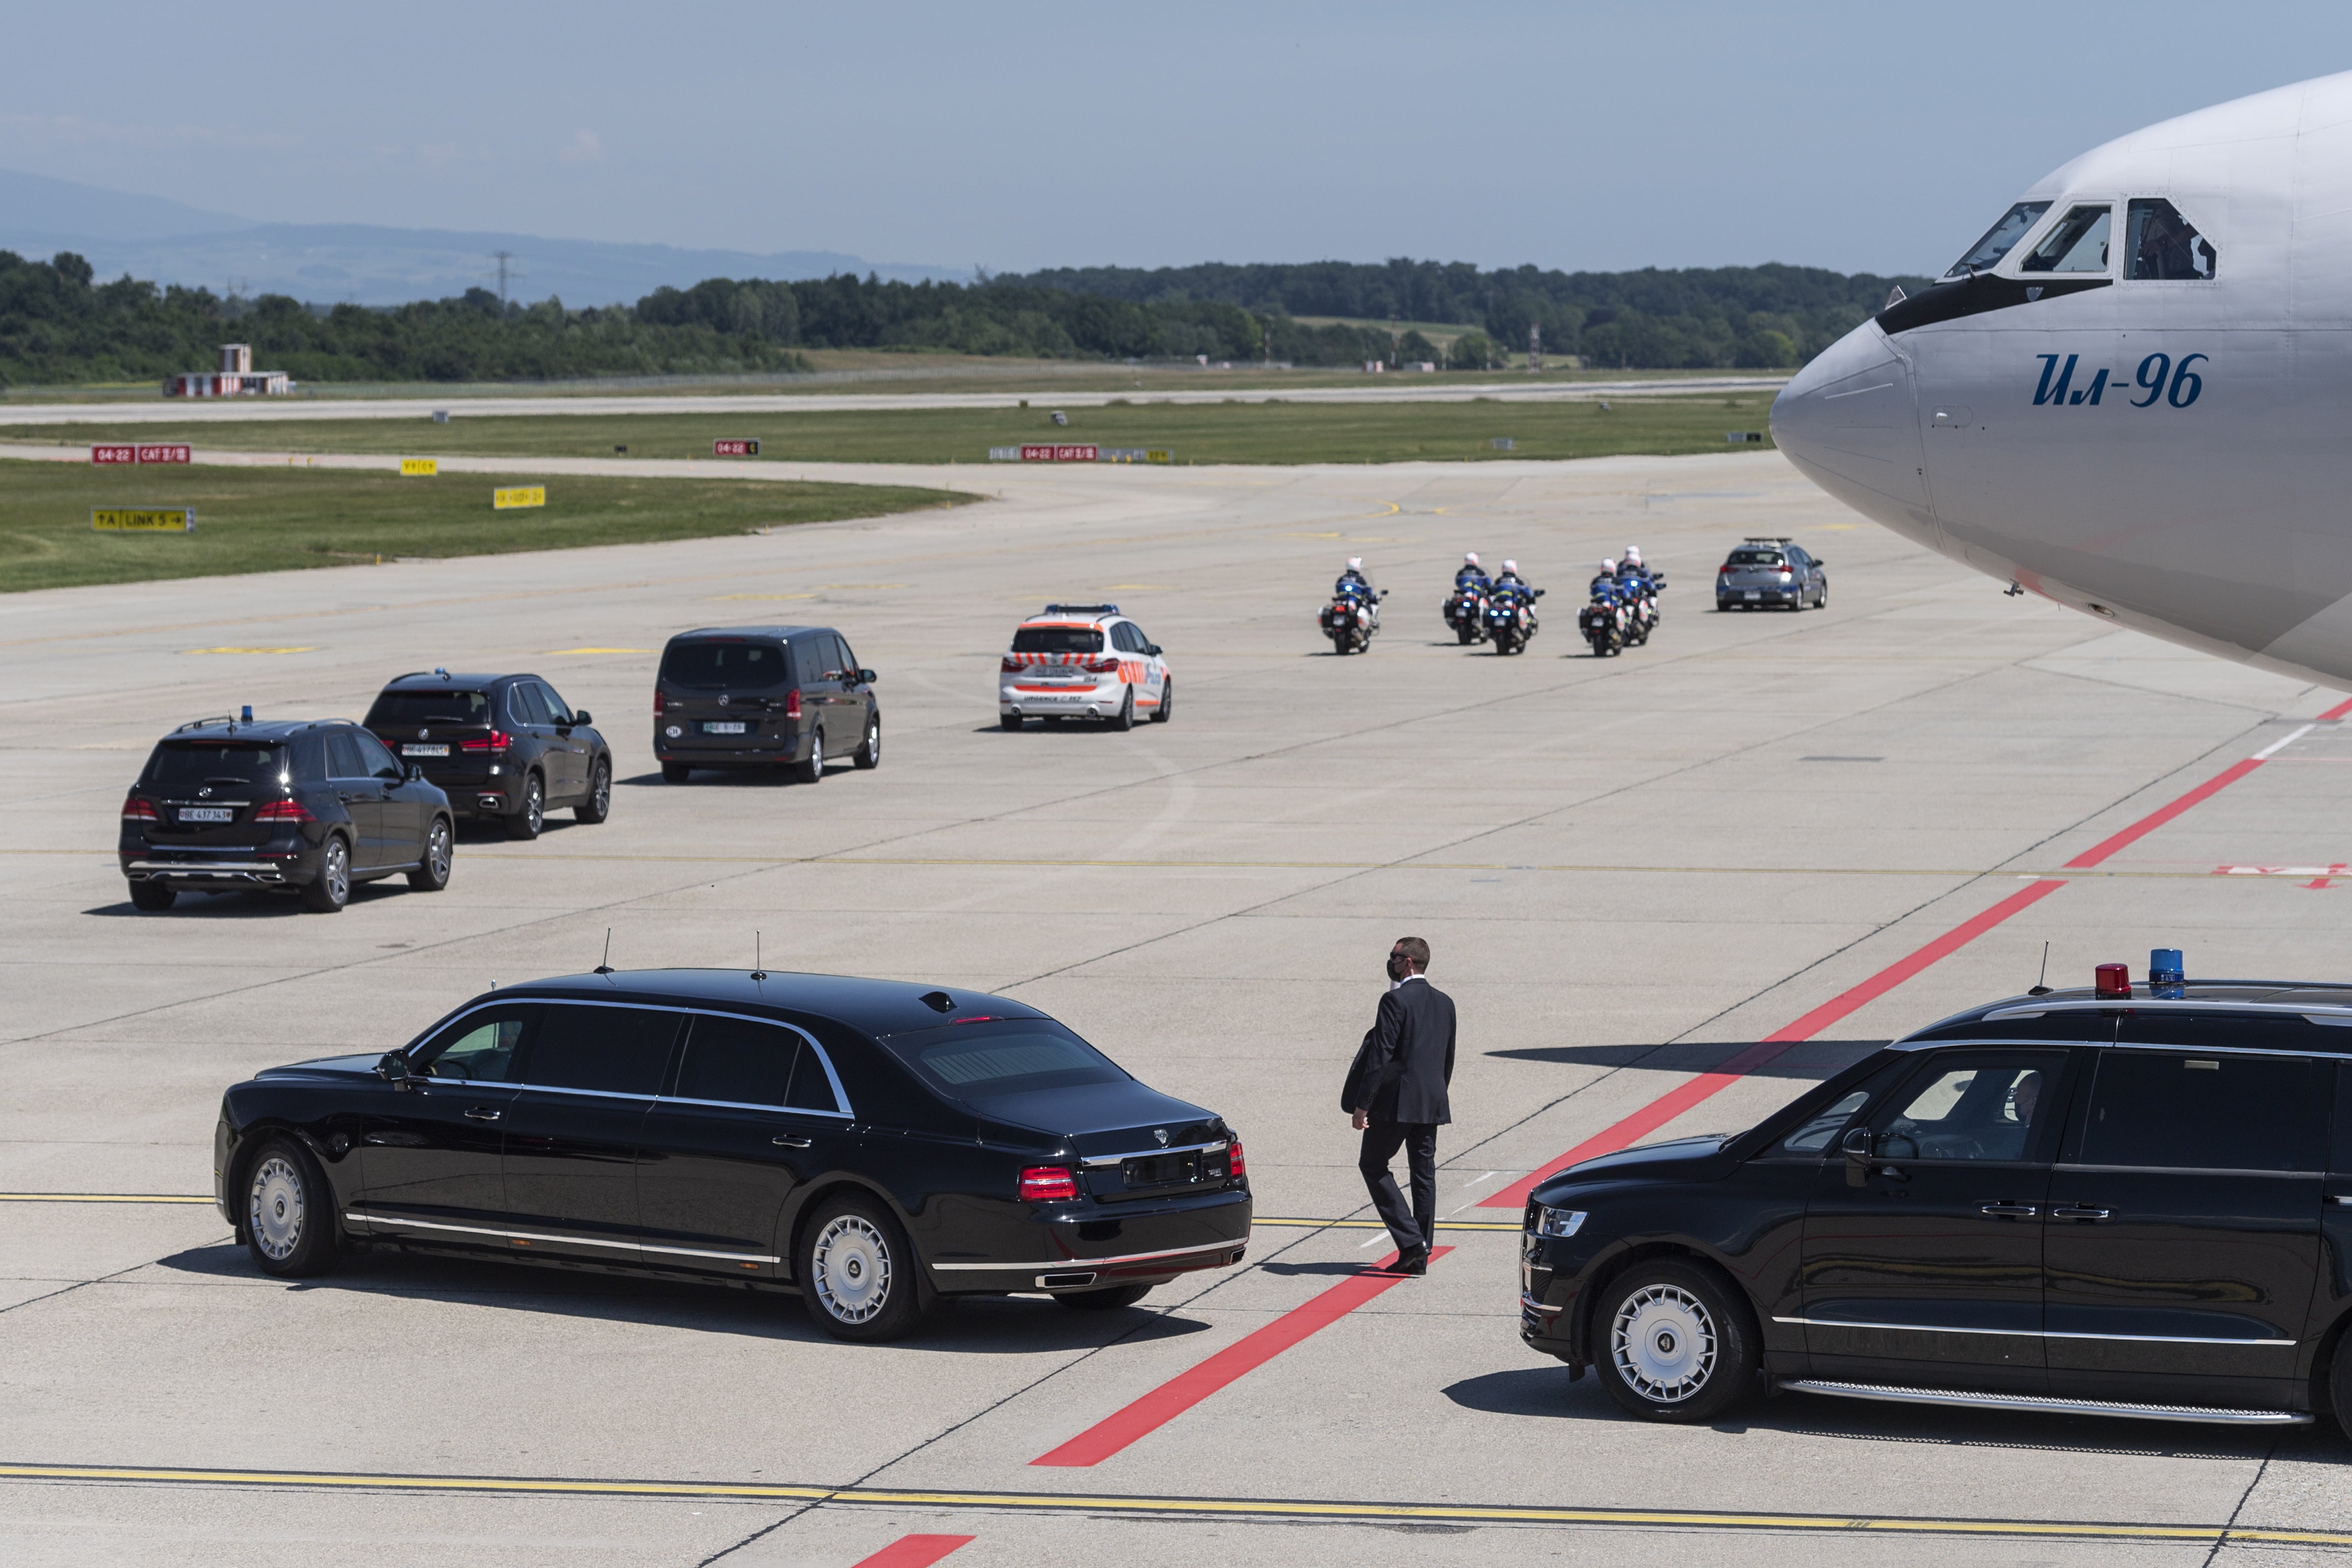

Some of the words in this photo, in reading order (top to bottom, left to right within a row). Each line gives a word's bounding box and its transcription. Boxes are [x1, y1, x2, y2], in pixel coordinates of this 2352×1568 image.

[2032, 352, 2209, 408] Ил-96
[97, 448, 131, 462] 04-22
[141, 448, 162, 461] CAT
[1025, 448, 1051, 460] 04-22
[107, 514, 115, 525] A
[125, 514, 154, 526] LINK
